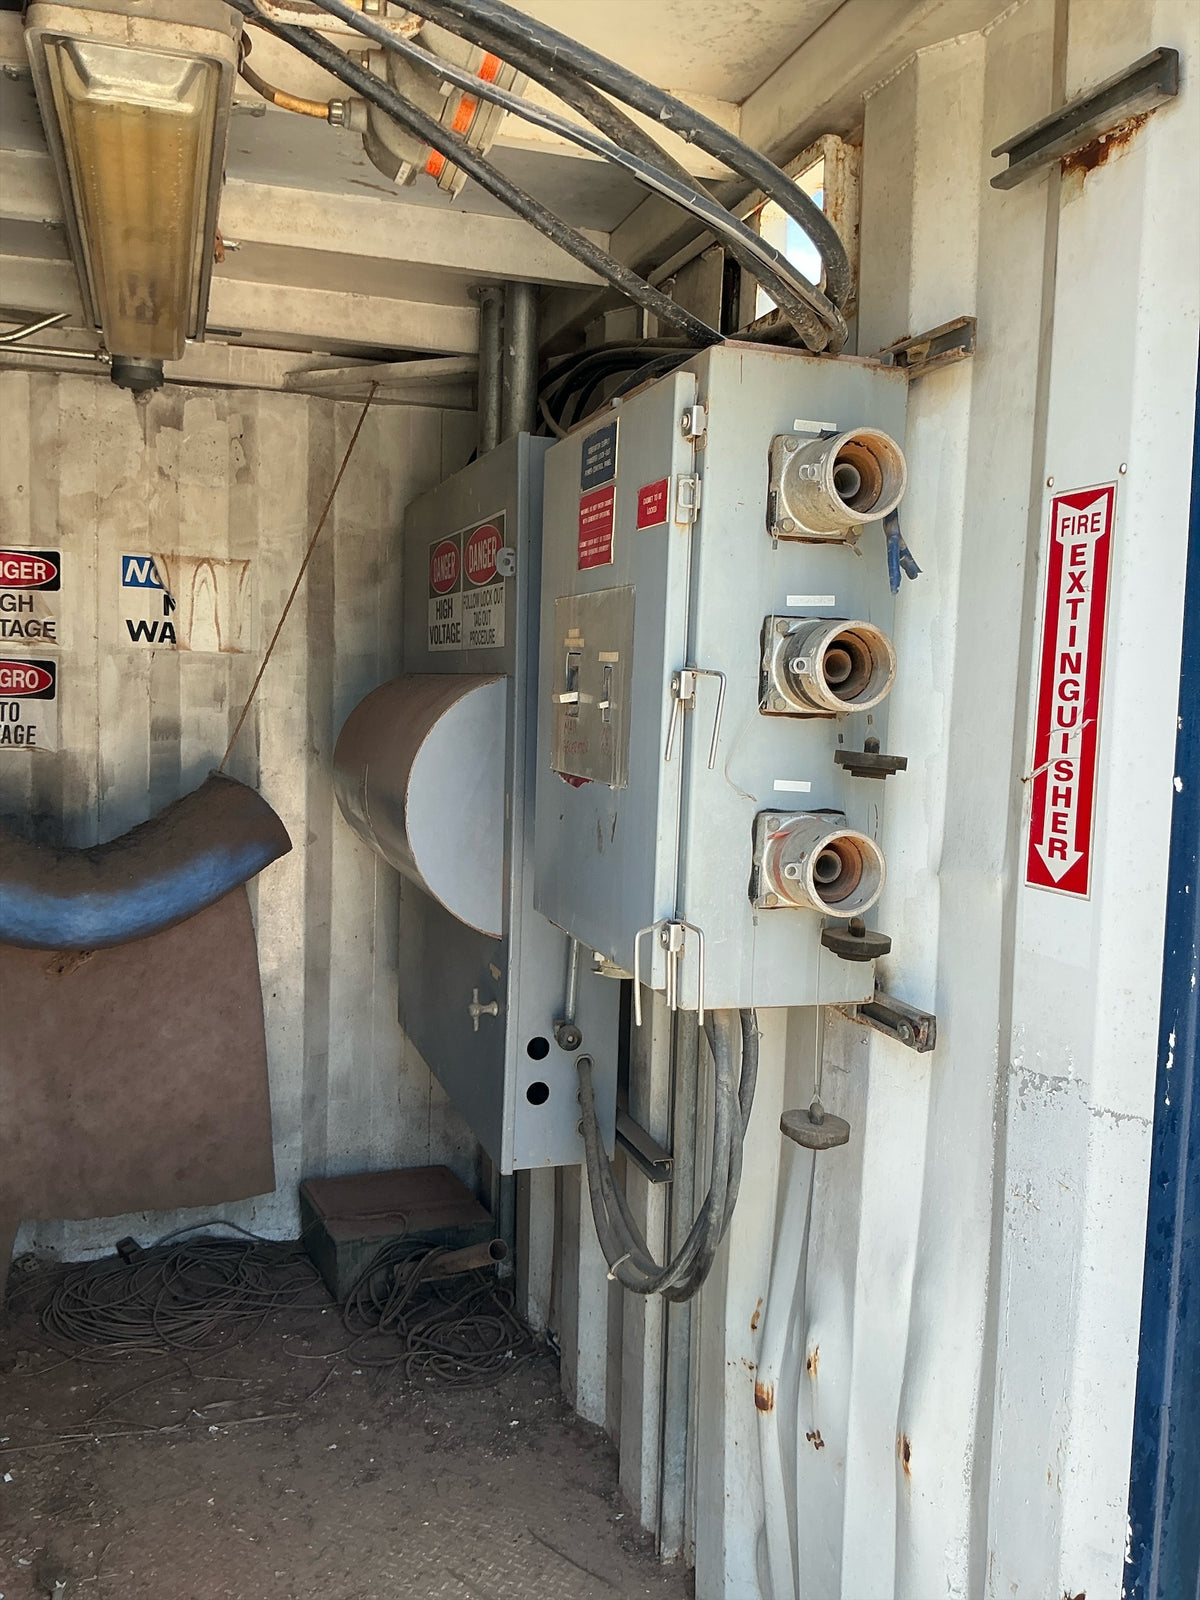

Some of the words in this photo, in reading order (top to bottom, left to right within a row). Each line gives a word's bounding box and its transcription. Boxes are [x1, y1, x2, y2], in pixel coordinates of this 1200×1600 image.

[1061, 512, 1101, 537] FIRE
[468, 536, 497, 574] DANGER
[433, 551, 456, 583] DANGER
[0, 593, 33, 612] GH
[494, 586, 504, 604] OUT
[435, 598, 453, 620] HIGH
[482, 609, 491, 626] OUT
[0, 618, 56, 639] TAGE
[429, 622, 461, 645] VOLTAGE
[470, 628, 496, 646] PROCEDURE
[0, 668, 39, 689] GRO
[0, 702, 20, 722] TO
[1048, 543, 1087, 860] EXTINGUISHER
[0, 725, 37, 745] AGE
